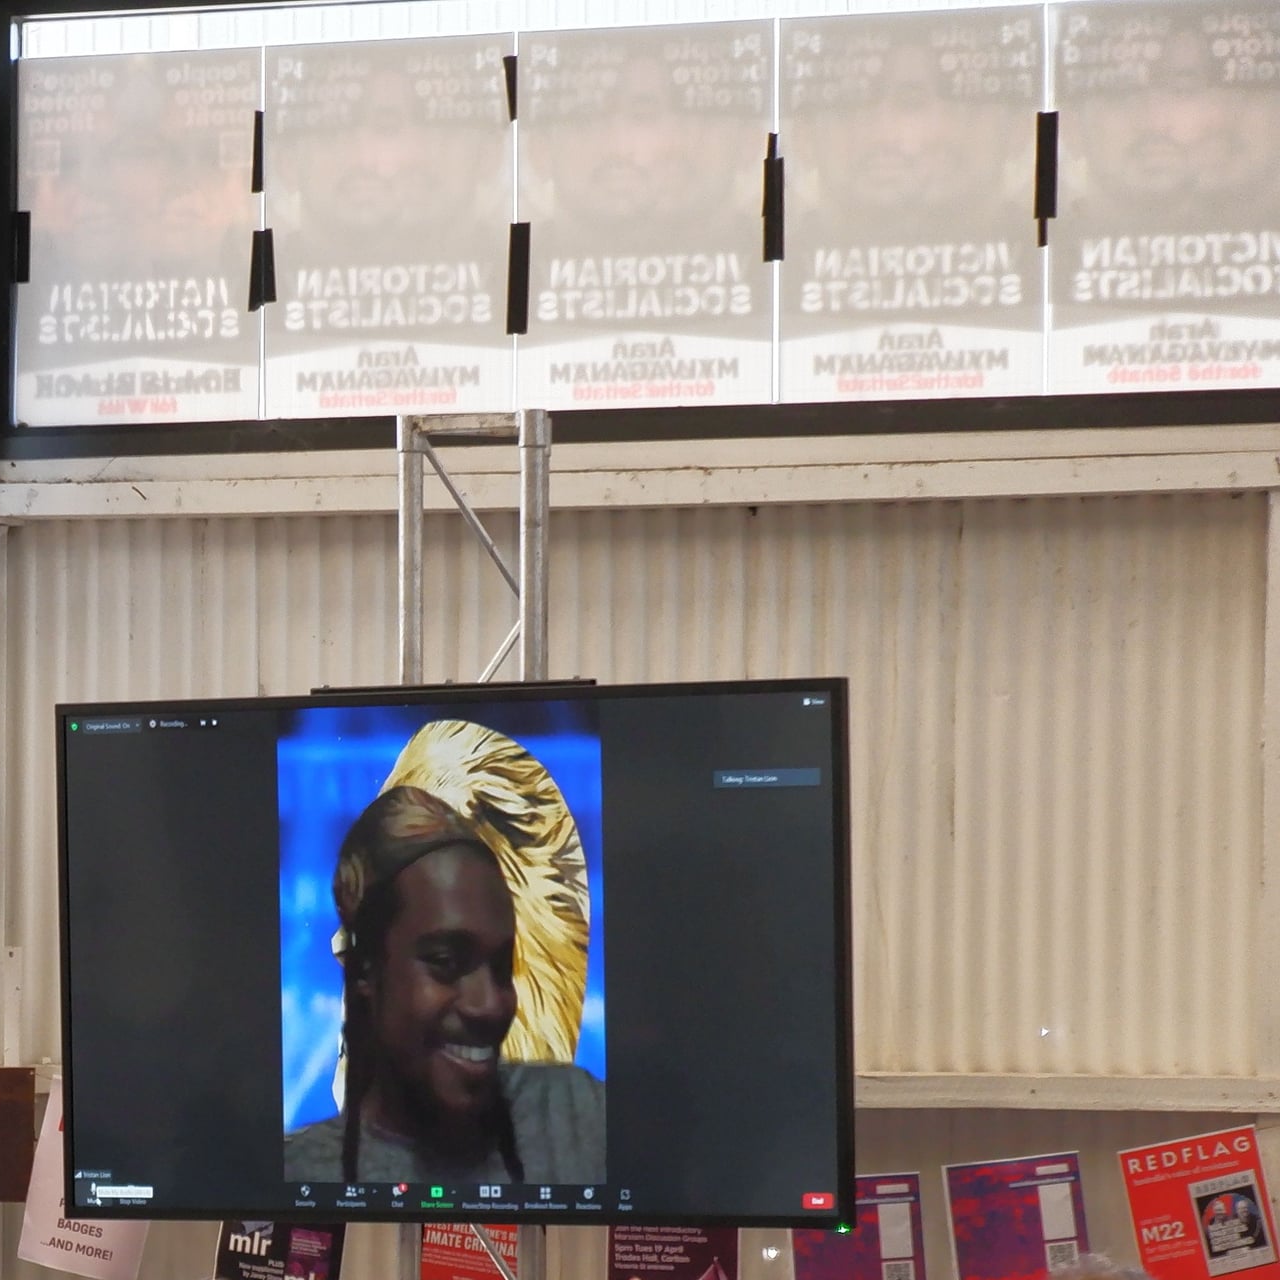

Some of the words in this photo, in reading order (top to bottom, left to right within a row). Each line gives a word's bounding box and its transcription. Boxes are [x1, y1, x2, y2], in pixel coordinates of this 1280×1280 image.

[1127, 1136, 1251, 1175] REDFLAG
[57, 1218, 103, 1238] BADGES
[1141, 1221, 1185, 1244] M22
[75, 1243, 113, 1261] MORE!
[228, 1231, 272, 1257] mlr
